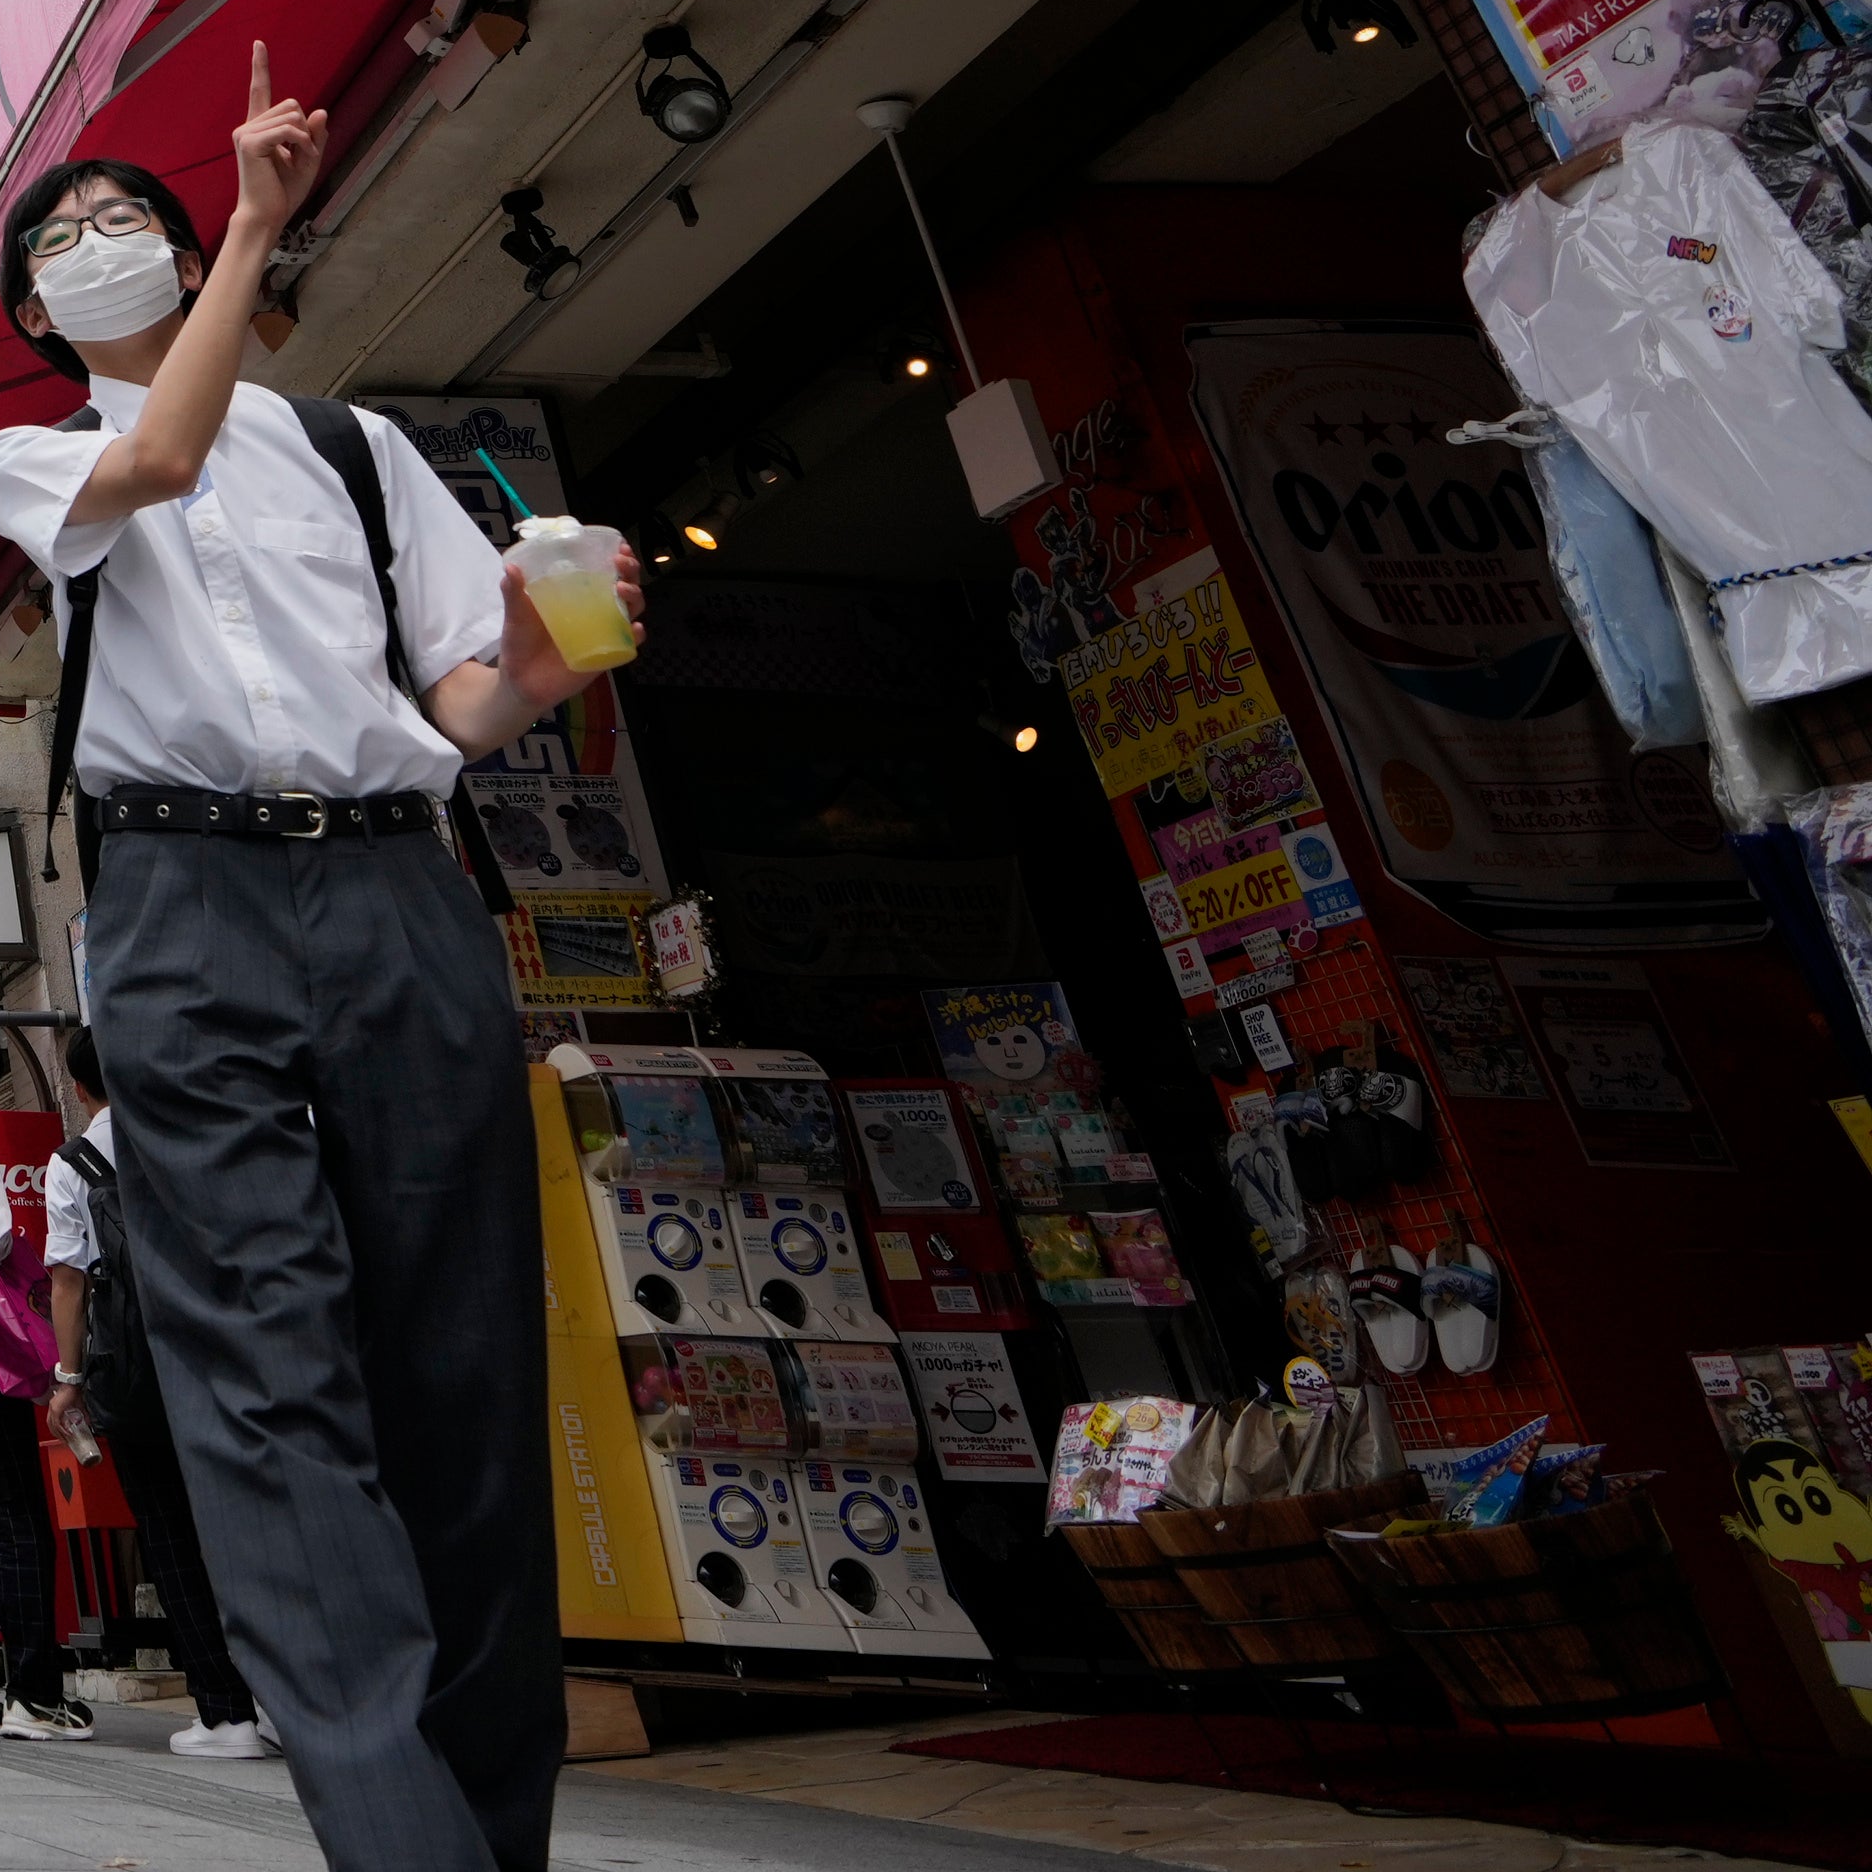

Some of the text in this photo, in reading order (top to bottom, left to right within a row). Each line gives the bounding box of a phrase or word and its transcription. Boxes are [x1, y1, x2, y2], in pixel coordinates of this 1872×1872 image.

[1569, 83, 1597, 105] PayPay
[1667, 235, 1717, 264] NEW
[1369, 558, 1508, 578] OKINAWA'S CRAFT
[1361, 580, 1554, 626] THE DRAFT
[1389, 783, 1450, 829] お酒
[537, 892, 561, 904] gacha
[815, 879, 876, 907] ORION
[878, 880, 946, 909] DRAFT
[655, 915, 685, 941] Tax 免
[660, 942, 691, 971] Free 税
[937, 990, 1034, 1026] 沖縄だけの
[1244, 1010, 1266, 1024] SHOP
[1248, 1022, 1265, 1035] TAX
[1252, 1032, 1274, 1047] FREE
[911, 1341, 978, 1352] AKOYA PEARL
